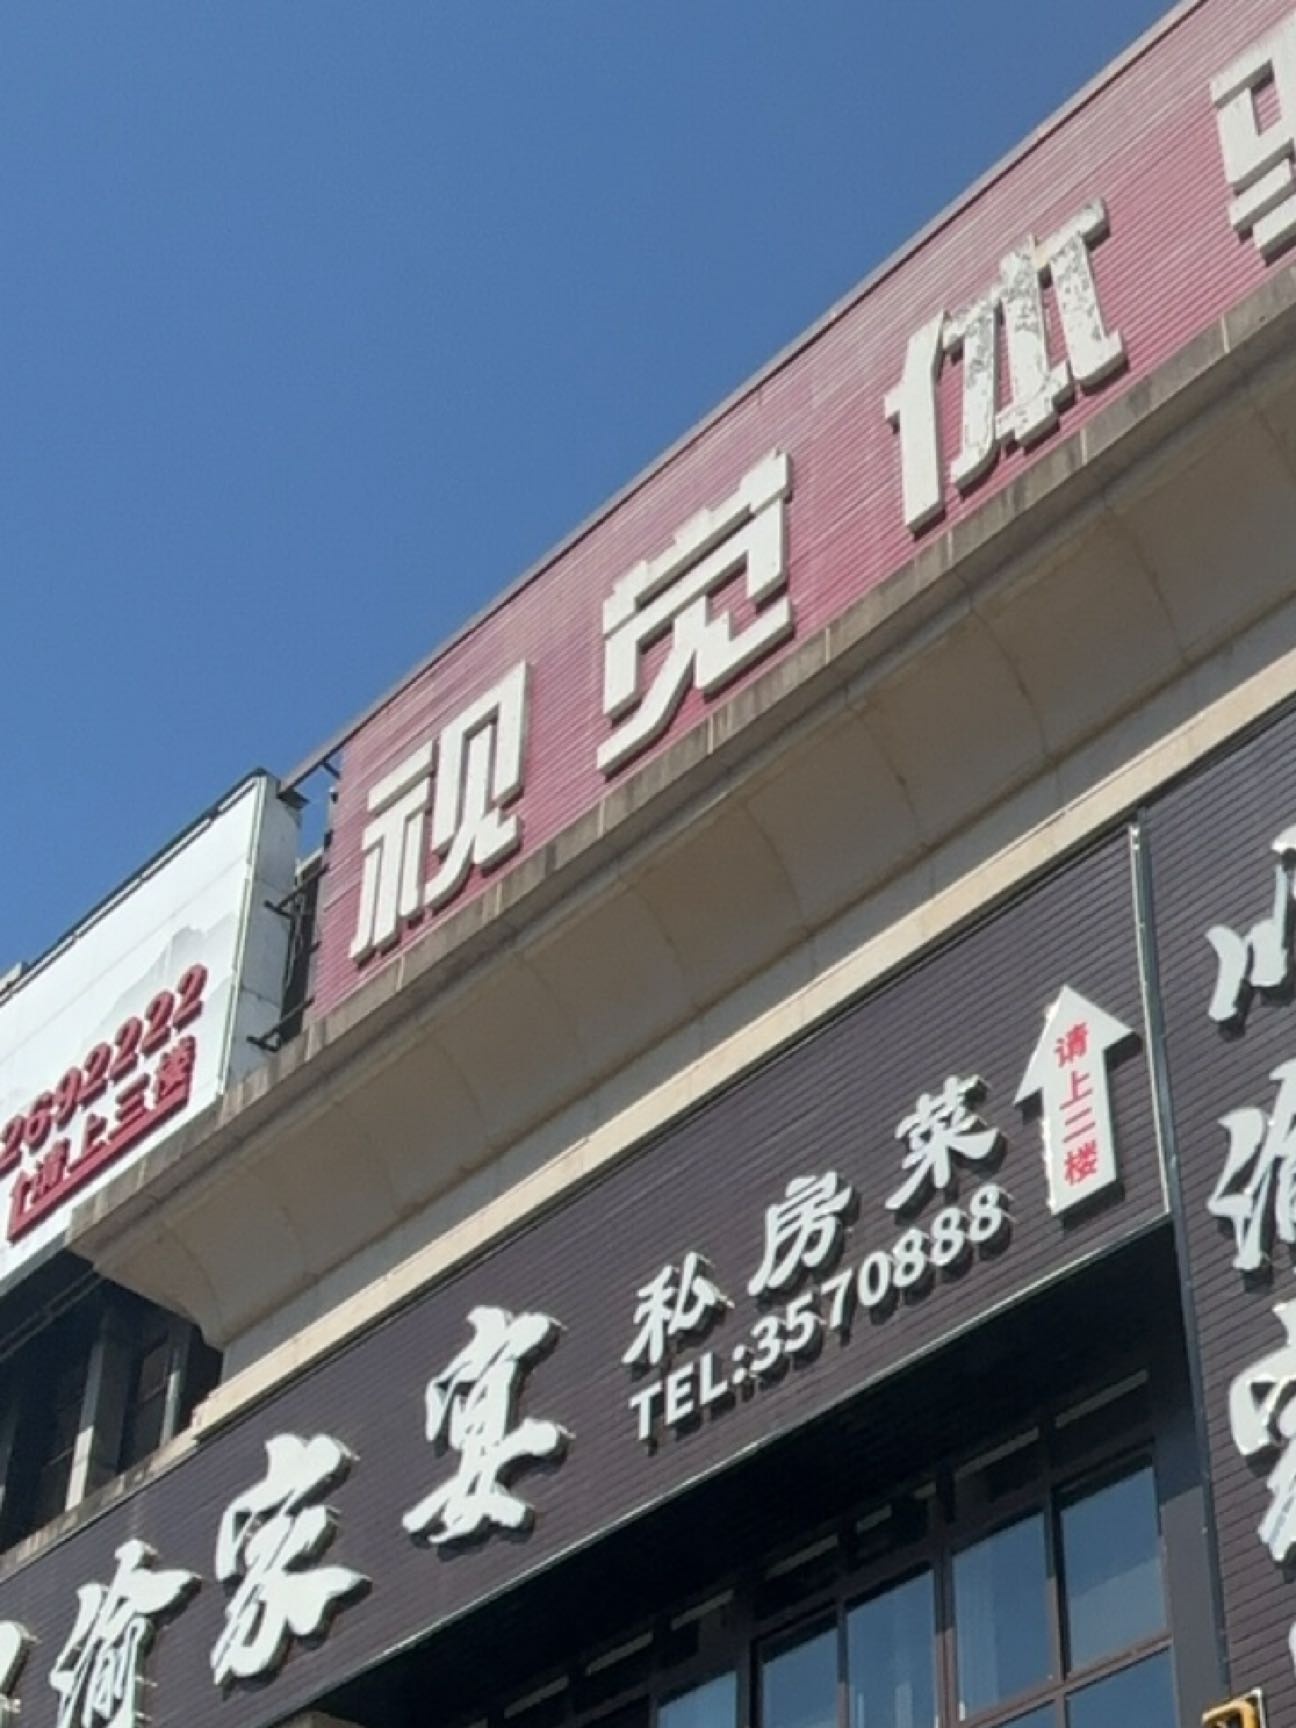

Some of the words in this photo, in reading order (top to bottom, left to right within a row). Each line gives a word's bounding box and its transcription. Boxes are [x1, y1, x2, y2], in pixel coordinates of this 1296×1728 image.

[622, 1074, 998, 1364] 私房菜
[1052, 1022, 1099, 1186] 请上二楼
[628, 1183, 1000, 1440] TEL:3570888
